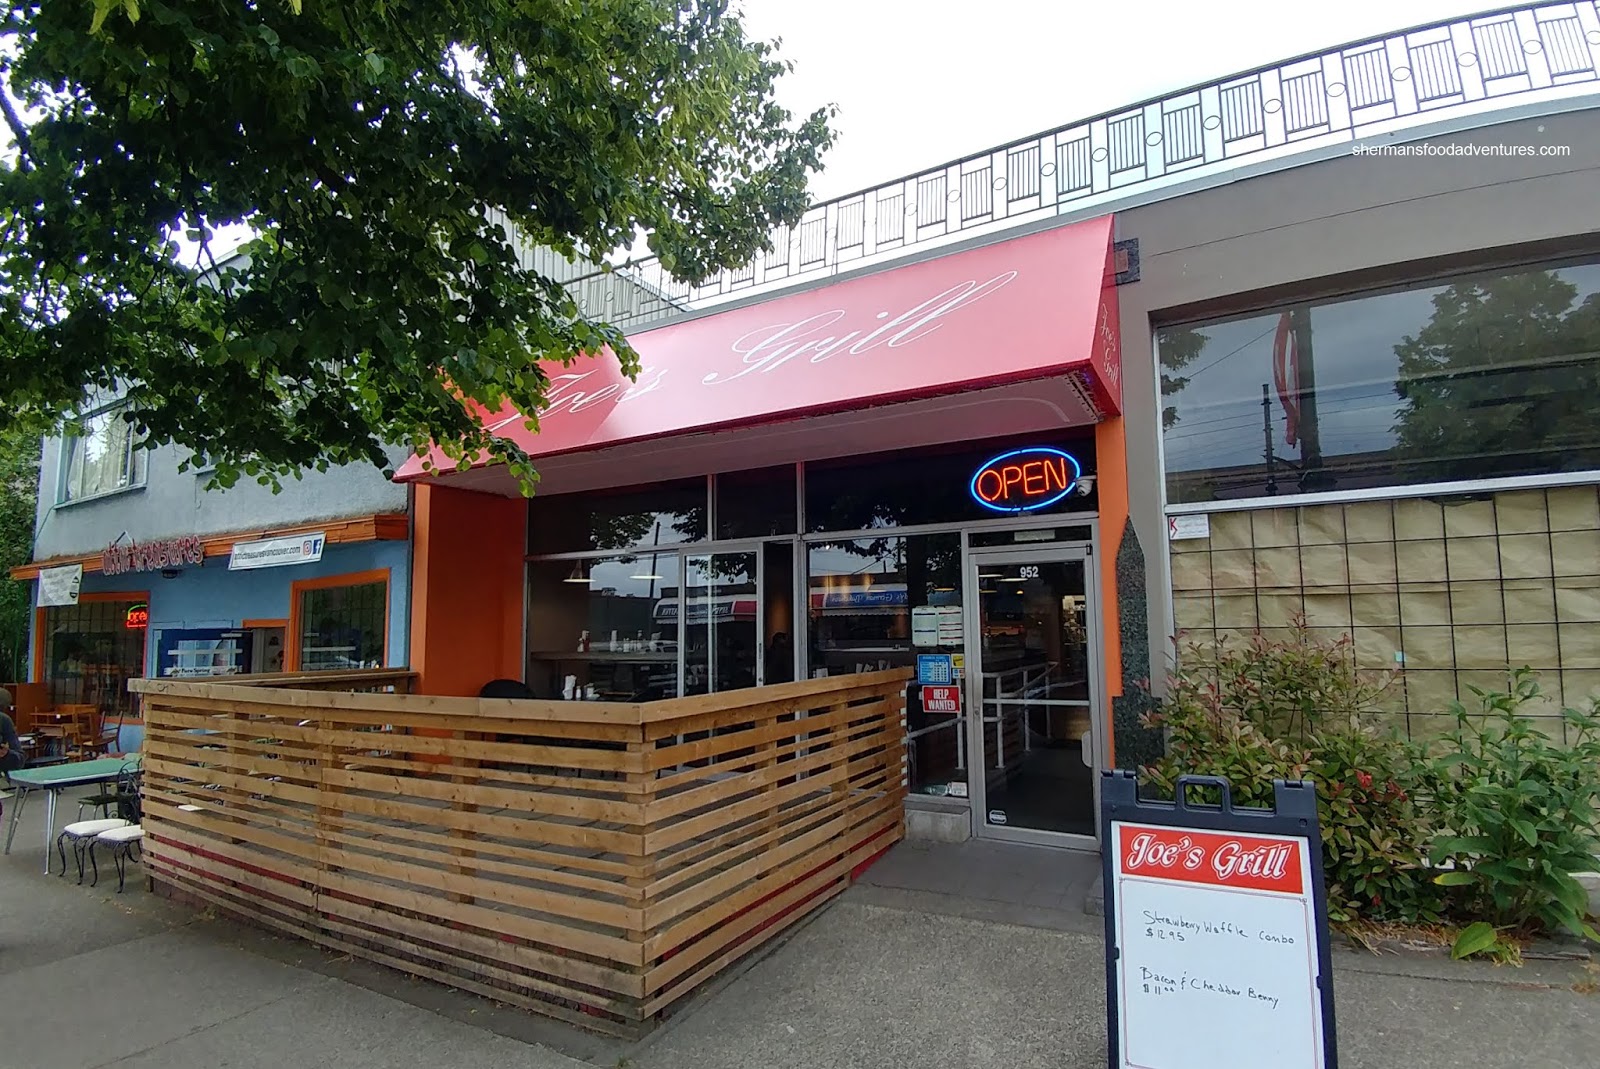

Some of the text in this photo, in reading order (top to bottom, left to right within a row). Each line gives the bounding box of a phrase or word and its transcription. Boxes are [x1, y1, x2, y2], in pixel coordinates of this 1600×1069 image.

[702, 271, 1017, 385] Grill
[977, 457, 1067, 501] OPEN
[1020, 566, 1039, 578] 952
[927, 699, 956, 711] WANTED
[933, 688, 949, 700] HELP
[1126, 832, 1293, 880] Joe's Grill
[1143, 910, 1200, 934] Strawberry
[1203, 921, 1248, 938] Waffle
[1139, 966, 1177, 986] Bacon
[1248, 987, 1279, 1010] Benny
